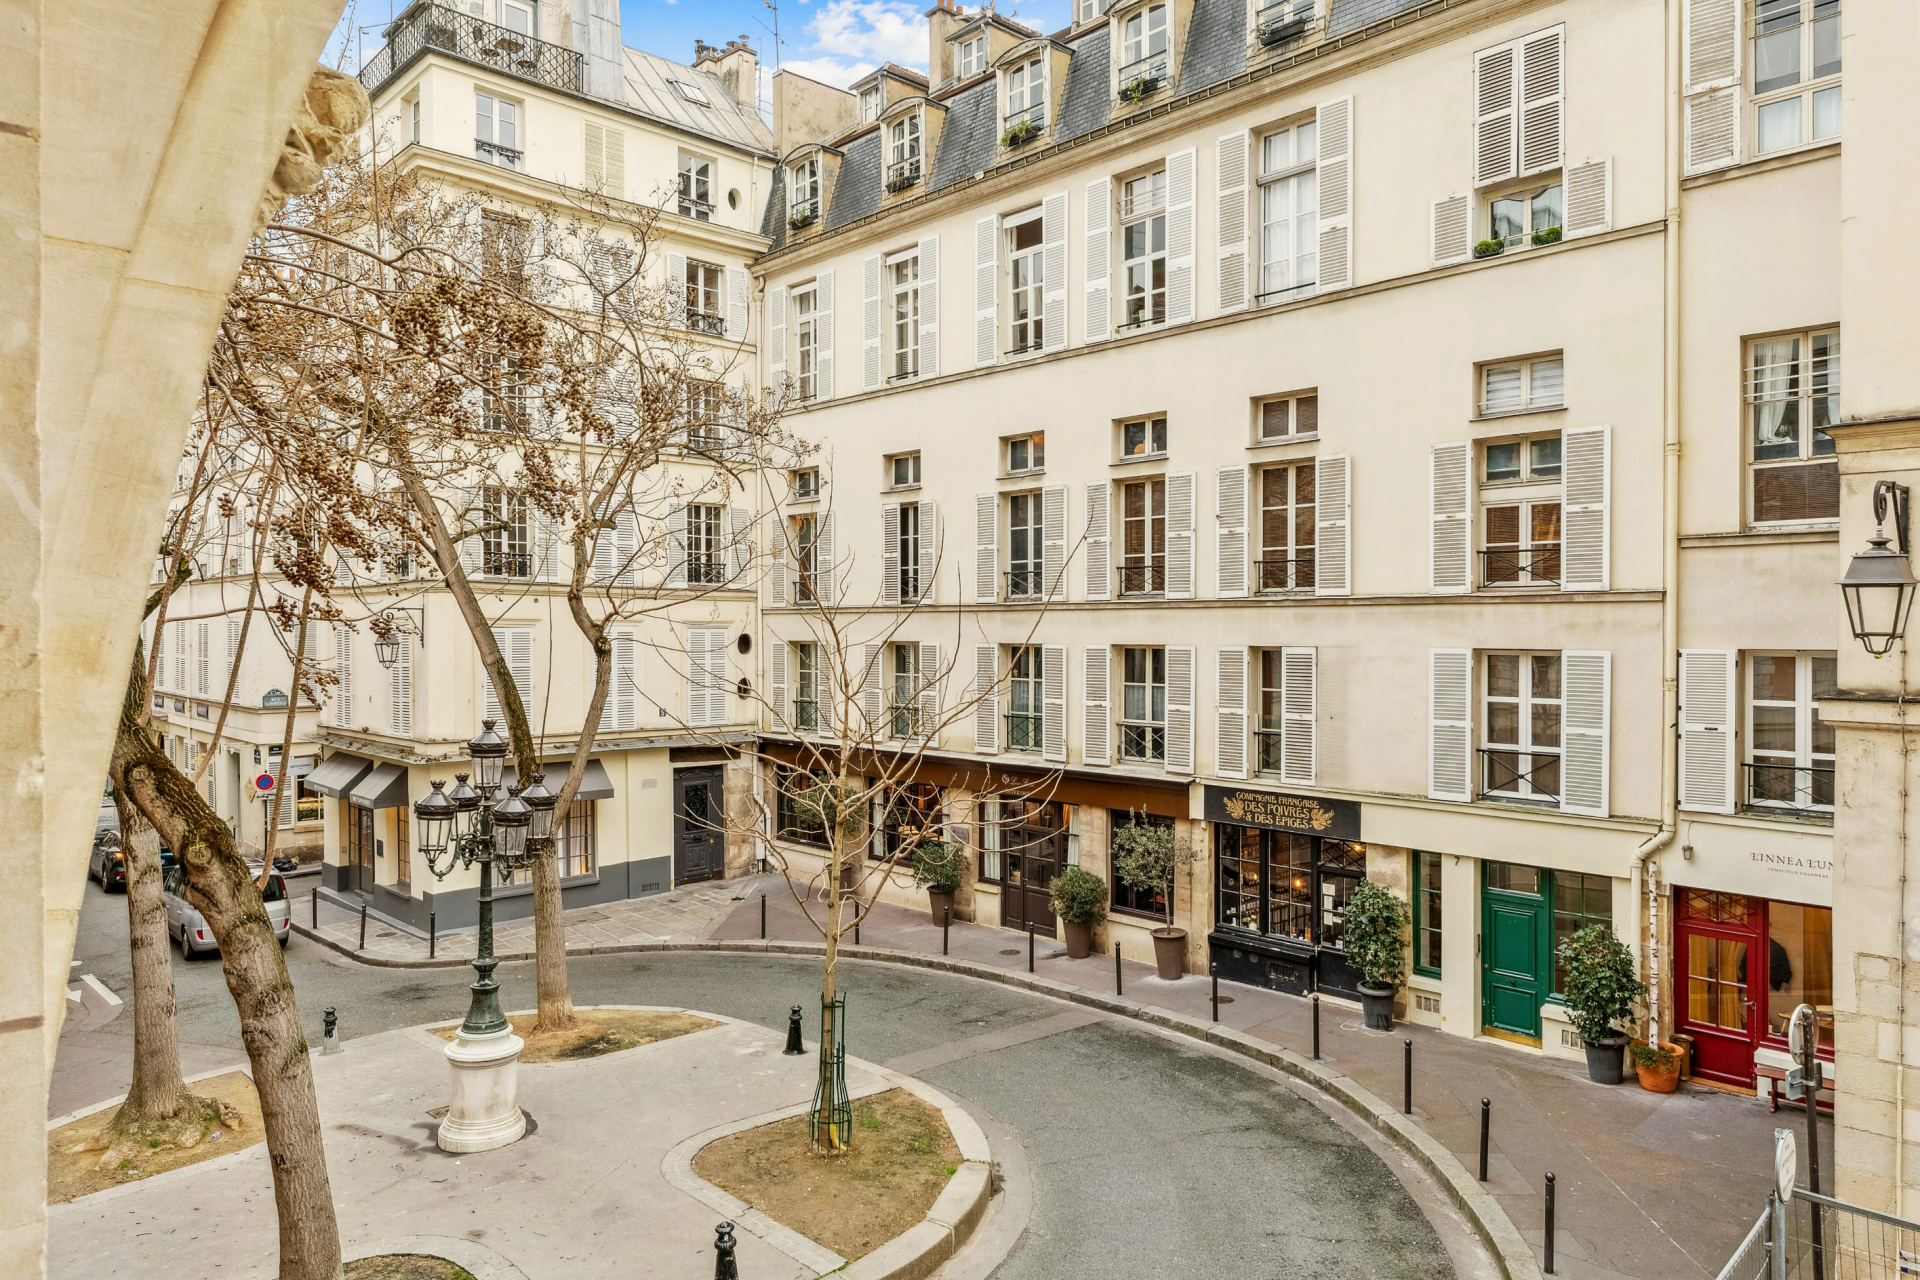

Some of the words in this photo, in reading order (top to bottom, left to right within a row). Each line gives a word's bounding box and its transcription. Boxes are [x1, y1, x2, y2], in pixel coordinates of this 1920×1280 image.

[1236, 792, 1277, 804] COMPAGNIE
[1244, 801, 1265, 813] DES
[1267, 804, 1310, 819] POIVRES
[1245, 812, 1252, 821] &
[1254, 813, 1273, 824] DES
[1454, 855, 1461, 866] 7
[1750, 852, 1804, 867] LINNEA
[1799, 871, 1829, 879] CASHMERE
